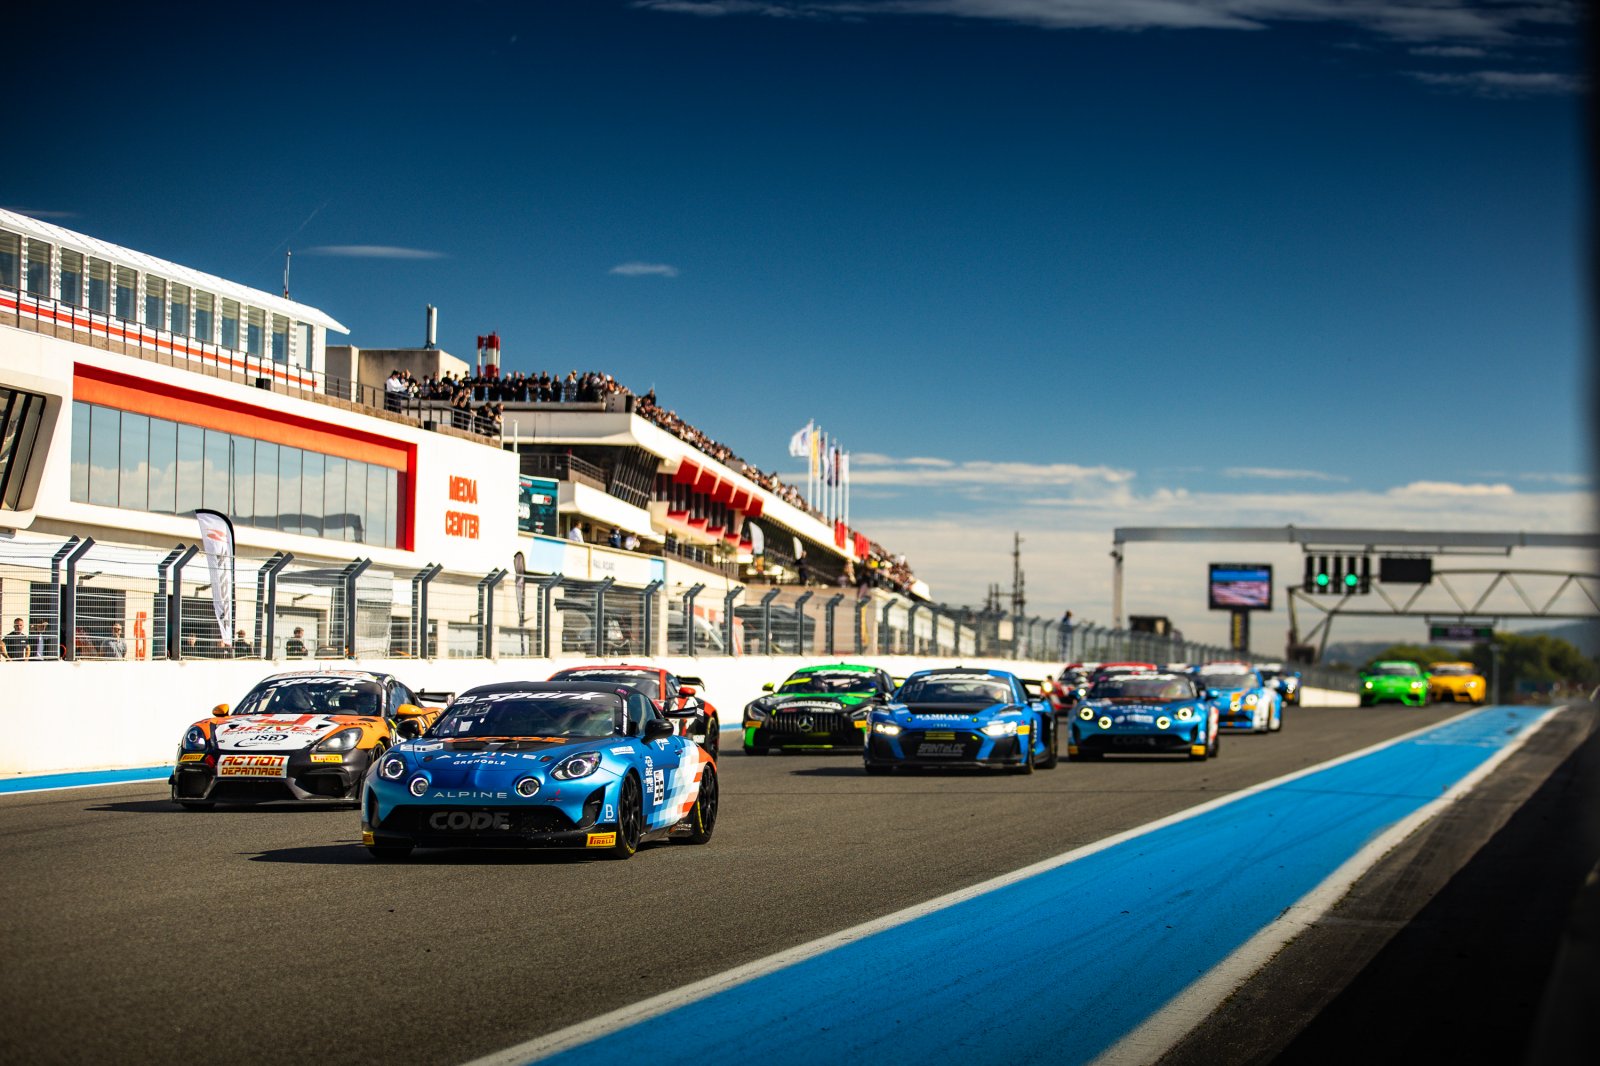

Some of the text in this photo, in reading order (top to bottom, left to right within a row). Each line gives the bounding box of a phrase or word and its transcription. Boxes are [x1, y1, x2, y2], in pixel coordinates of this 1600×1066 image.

[449, 475, 478, 504] MEDIA
[445, 511, 480, 539] CENTER
[269, 678, 368, 688] spark
[476, 691, 608, 702] spark
[221, 755, 285, 766] ACTION
[436, 752, 537, 760] ALPINE
[221, 767, 283, 776] DEPANNAGE
[433, 791, 507, 799] ALPINE
[429, 811, 510, 831] CODE
[590, 834, 614, 845] PIRELLI
